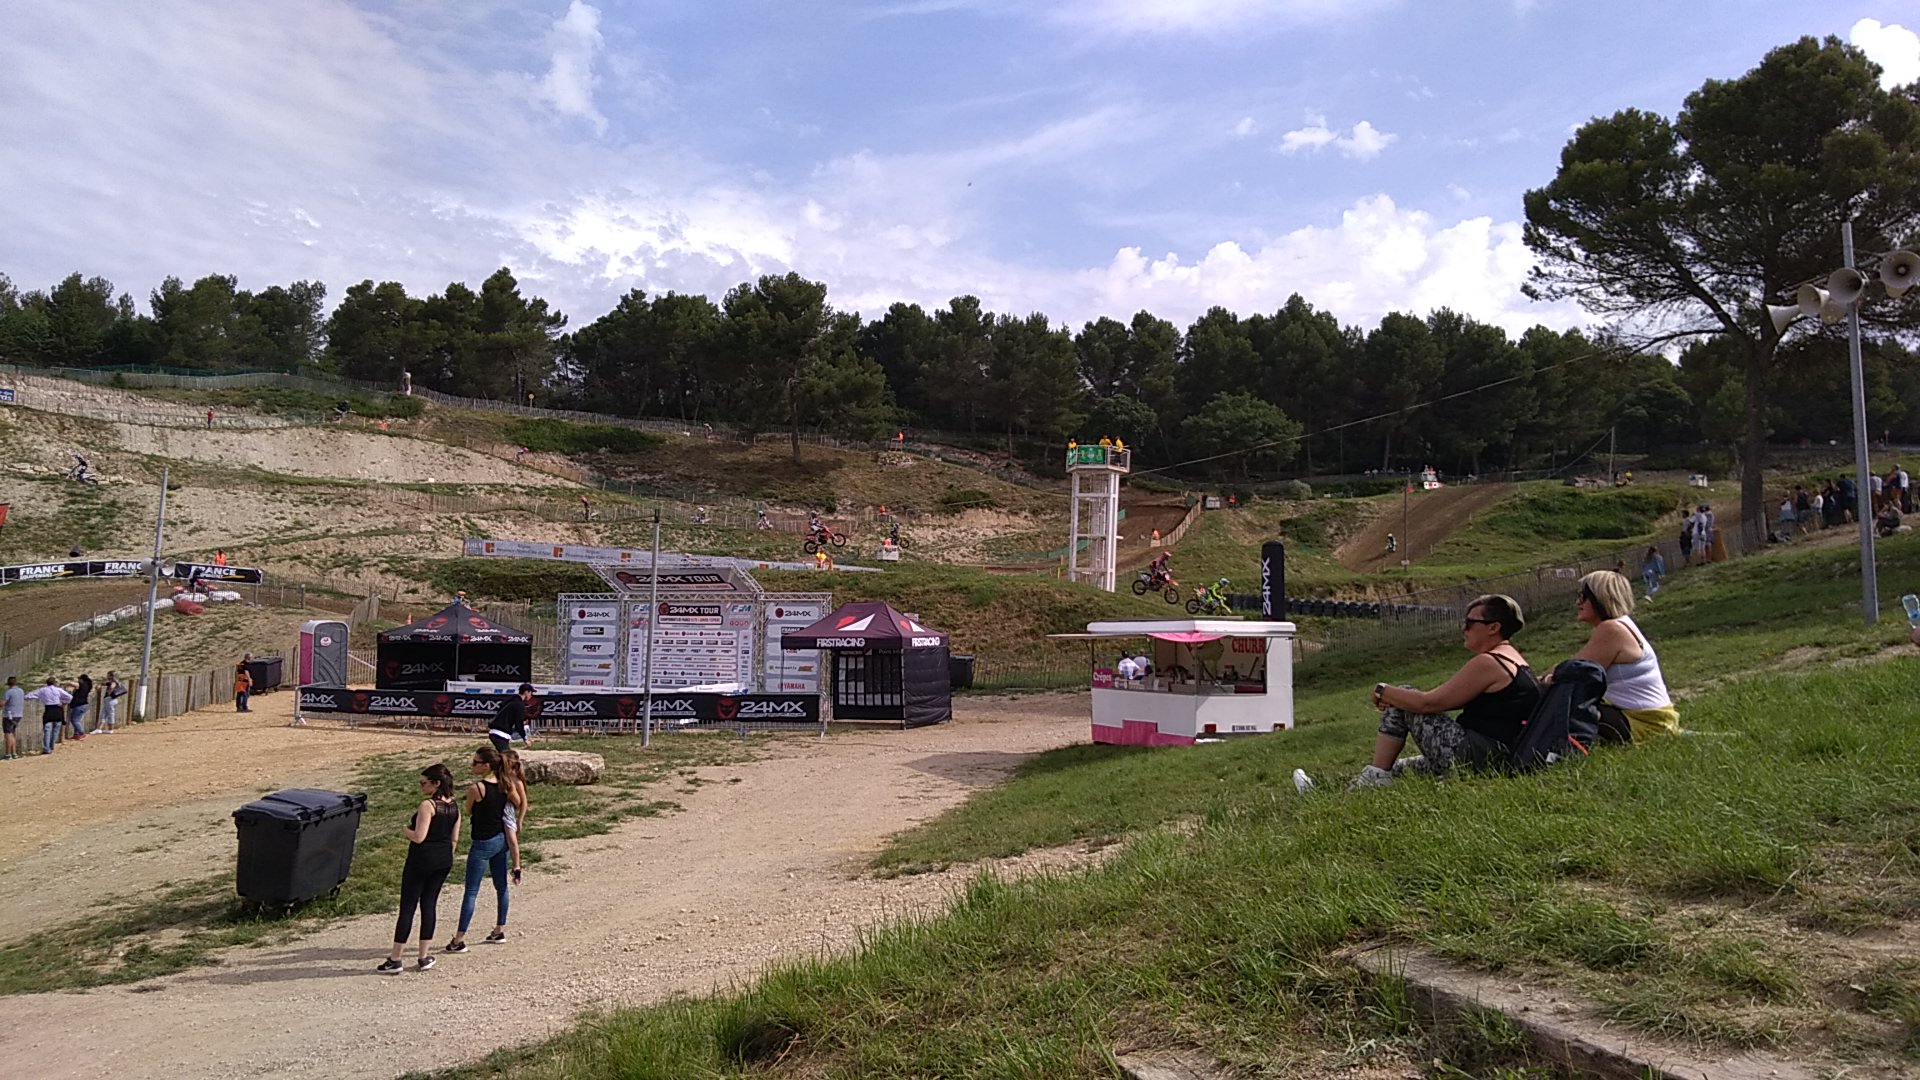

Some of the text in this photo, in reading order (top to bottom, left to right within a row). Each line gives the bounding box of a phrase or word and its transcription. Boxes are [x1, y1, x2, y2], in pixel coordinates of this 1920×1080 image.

[20, 565, 65, 576] FRANCE
[105, 562, 142, 570] FRANC
[1262, 557, 1271, 616] 24MX
[429, 634, 453, 642] 24MX
[816, 638, 866, 647] FIRSTRACING
[911, 637, 941, 647] FIRSTRACING
[401, 663, 445, 675] 24MX
[478, 664, 521, 676] 24MX
[783, 682, 806, 690] YAMAHA
[300, 693, 336, 704] 4MX
[370, 696, 417, 708] 24MX
[454, 699, 503, 711] 24MX
[543, 700, 596, 712] 24MX
[740, 701, 805, 713] 24MX
